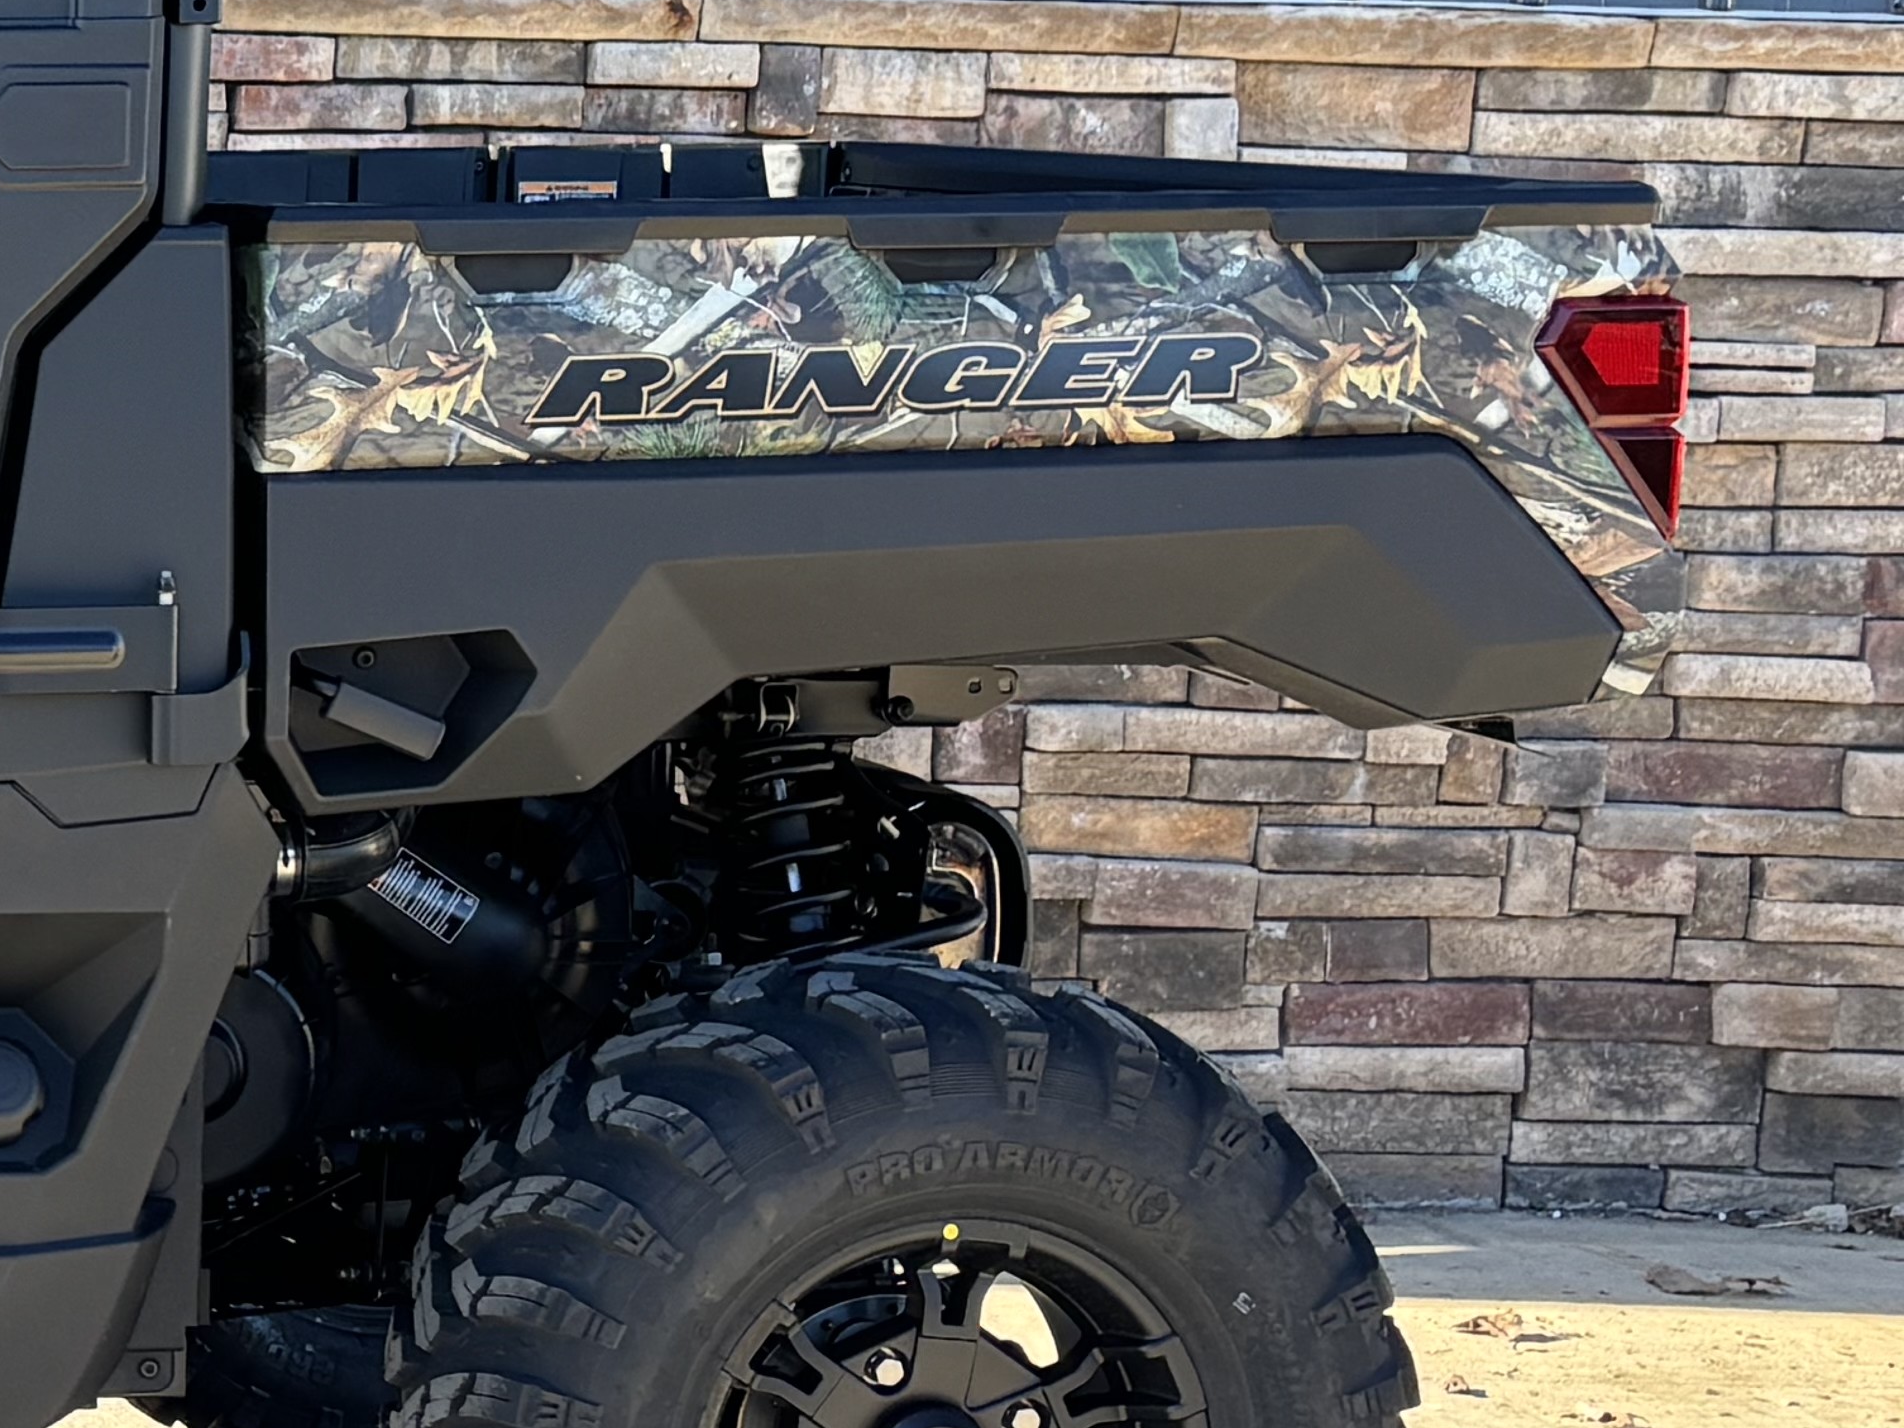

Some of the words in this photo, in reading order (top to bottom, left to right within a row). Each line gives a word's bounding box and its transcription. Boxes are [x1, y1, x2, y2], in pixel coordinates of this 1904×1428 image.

[524, 331, 1265, 428] RANGER
[844, 1145, 944, 1197] PRO
[956, 1140, 1134, 1204] ARMOR
